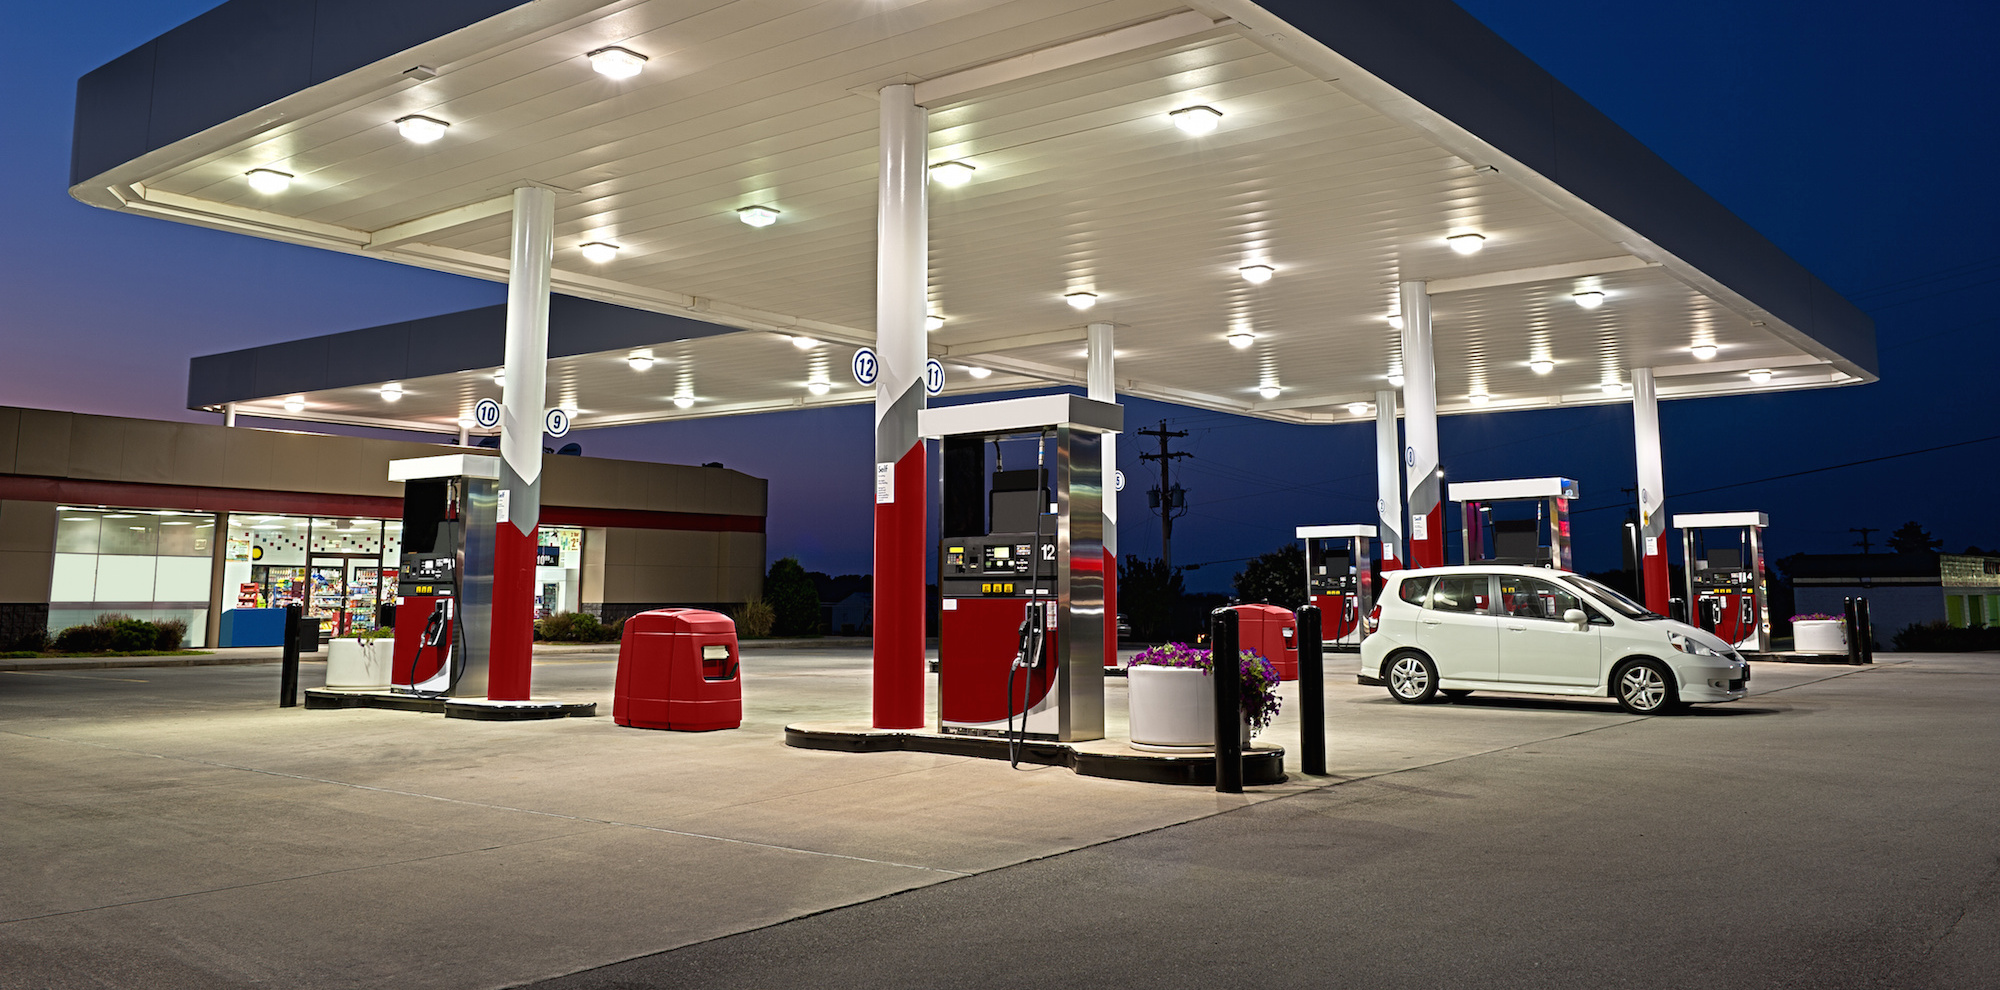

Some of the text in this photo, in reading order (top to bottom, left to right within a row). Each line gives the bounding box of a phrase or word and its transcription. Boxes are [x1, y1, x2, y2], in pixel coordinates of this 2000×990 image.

[859, 358, 874, 377] 12
[927, 368, 939, 386] 11
[481, 406, 495, 421] 10
[553, 415, 561, 429] 9
[1041, 544, 1056, 561] 12
[1351, 576, 1357, 584] 2
[1746, 572, 1753, 580] 4
